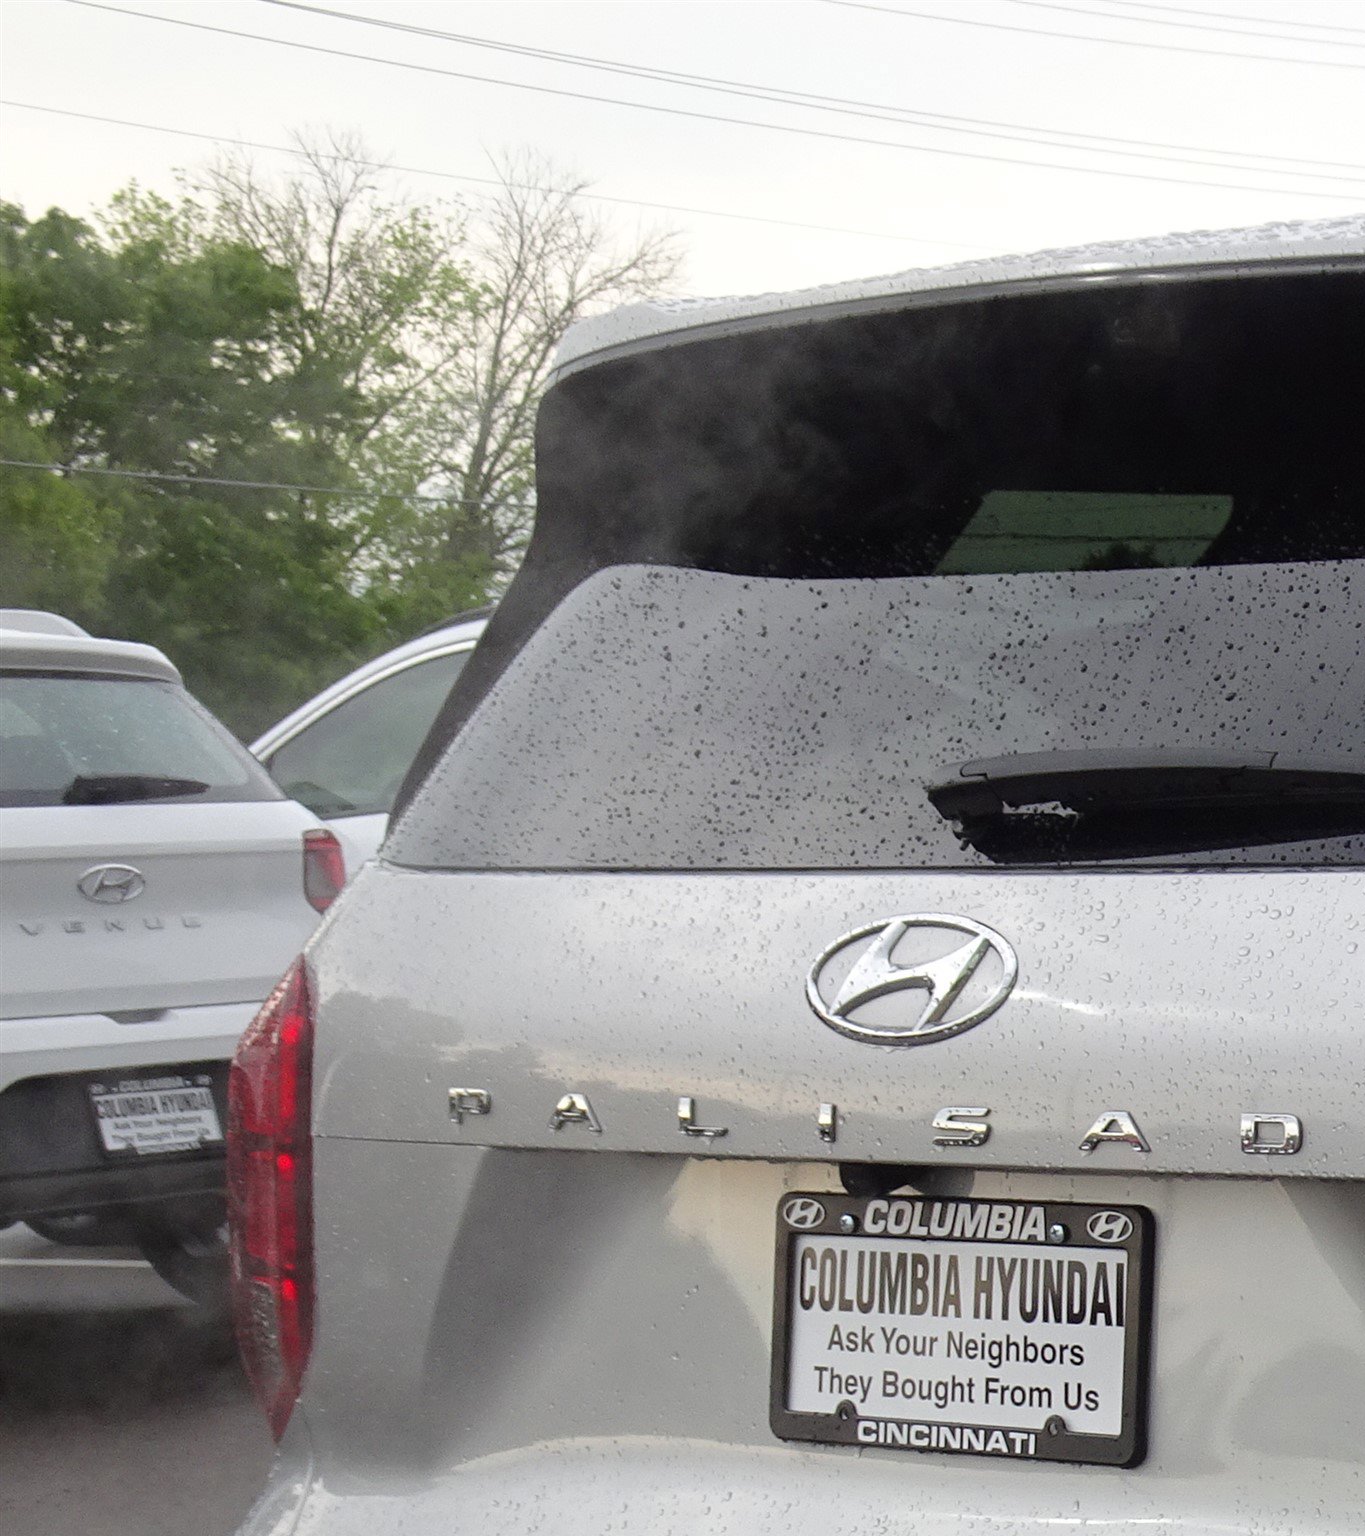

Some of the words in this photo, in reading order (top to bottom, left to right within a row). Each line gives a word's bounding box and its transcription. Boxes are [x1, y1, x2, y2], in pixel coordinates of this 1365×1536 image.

[863, 1198, 1047, 1242] COLUMBIA
[799, 1246, 962, 1319] COLUMBIA
[973, 1255, 1126, 1328] HYUNDAI
[827, 1323, 876, 1355] Ask
[880, 1326, 938, 1358] Your
[946, 1330, 1086, 1368] Neighbors
[814, 1365, 873, 1403] They
[882, 1370, 976, 1409] Bought
[985, 1377, 1052, 1409] From
[1063, 1382, 1100, 1411] Us
[856, 1418, 1038, 1456] CINCINNATI
